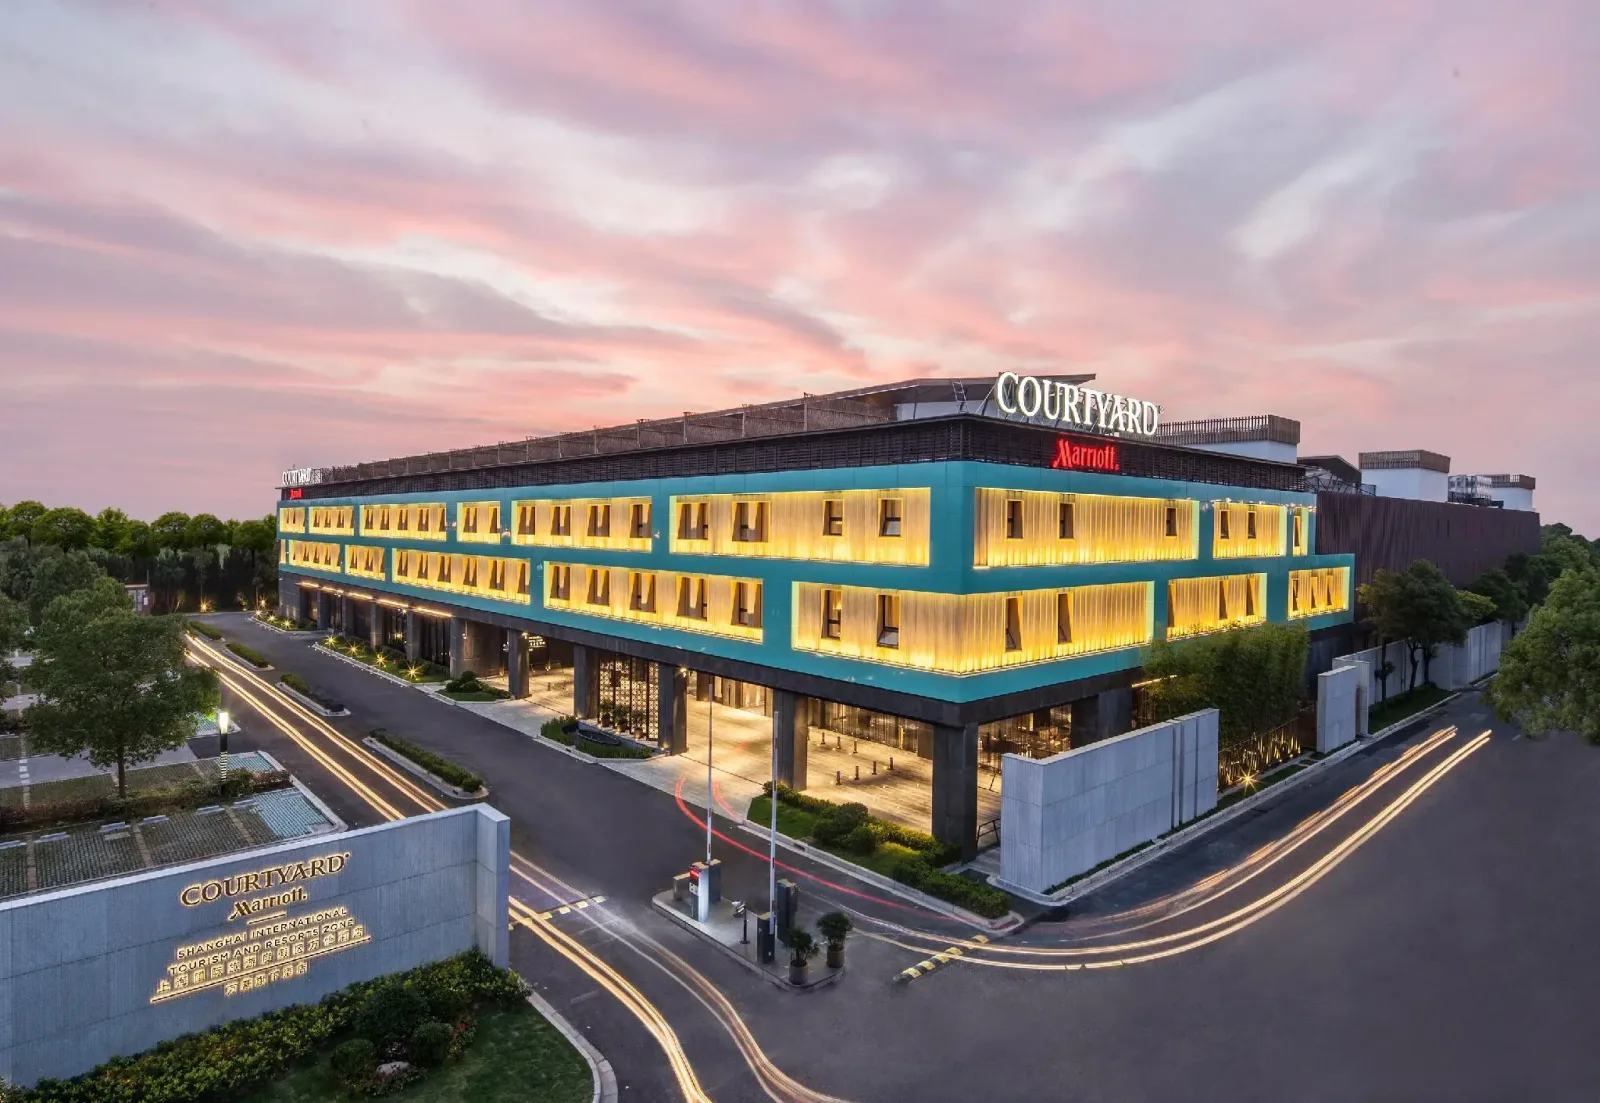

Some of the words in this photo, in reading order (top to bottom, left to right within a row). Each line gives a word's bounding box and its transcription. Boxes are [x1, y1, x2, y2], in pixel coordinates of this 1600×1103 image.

[997, 371, 1159, 435] COURTYARD
[181, 854, 346, 906] COURTYARD
[170, 953, 228, 975] TOURISM
[233, 944, 260, 958] AND
[265, 928, 318, 948] RESORTS
[323, 919, 354, 933] ZONE
[178, 933, 247, 959] SHANGHAI
[252, 908, 347, 938] INTERNATIONAL
